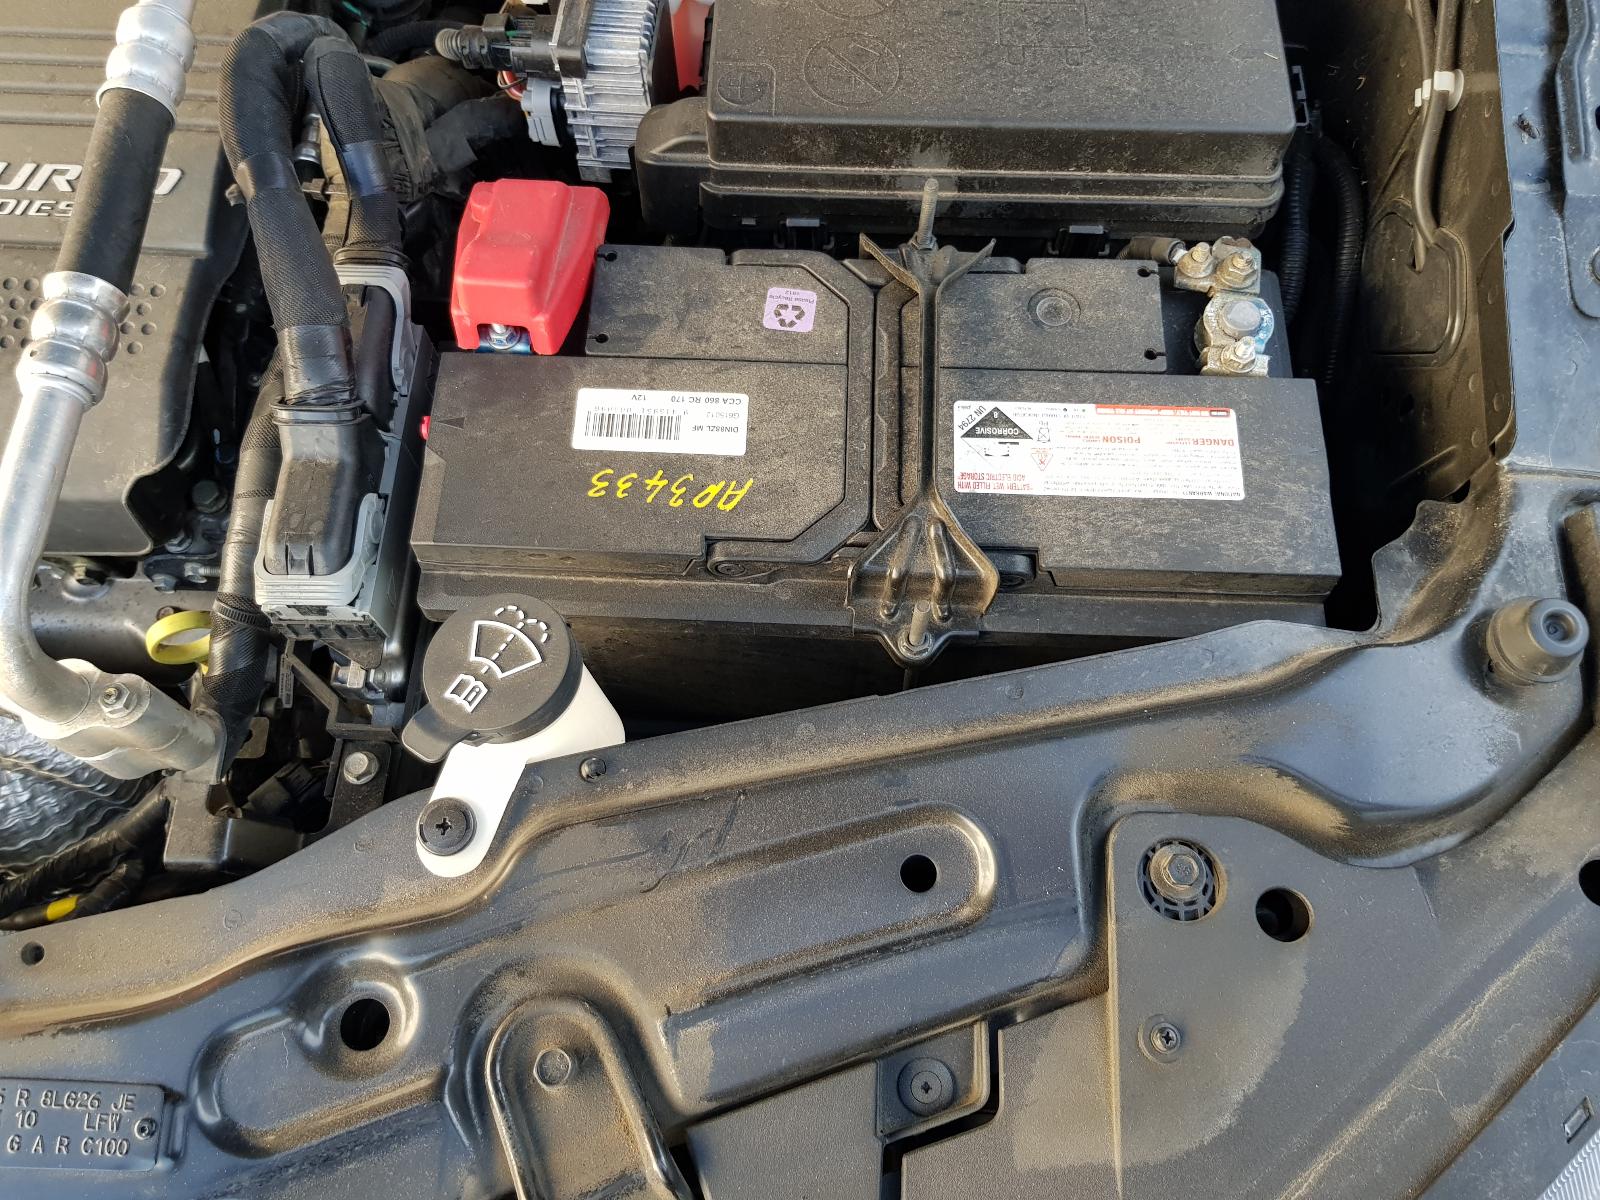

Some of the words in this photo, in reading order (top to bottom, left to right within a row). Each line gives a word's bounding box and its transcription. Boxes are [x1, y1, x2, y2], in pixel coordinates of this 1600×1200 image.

[0, 161, 182, 196] UR
[0, 198, 76, 217] DIES
[631, 394, 647, 402] 12V
[670, 395, 685, 404] 170
[688, 396, 702, 404] RC
[704, 396, 720, 405] 860
[721, 396, 742, 405] CCA
[974, 405, 987, 418] UN
[957, 413, 976, 431] 2794
[974, 426, 1019, 436] CORROSIVE
[1102, 435, 1141, 444] POISON
[1191, 437, 1235, 447] DANGER
[986, 472, 1012, 481] ELECTRIC
[957, 480, 972, 489] WITH
[972, 481, 991, 489] FILLED
[15, 1088, 31, 1108] R
[111, 1092, 137, 1113] JE
[15, 1109, 39, 1129] 10
[83, 1112, 123, 1134] LFW
[6, 1134, 22, 1154] G
[32, 1134, 45, 1155] A
[55, 1135, 71, 1155] R
[81, 1136, 131, 1157] C100
